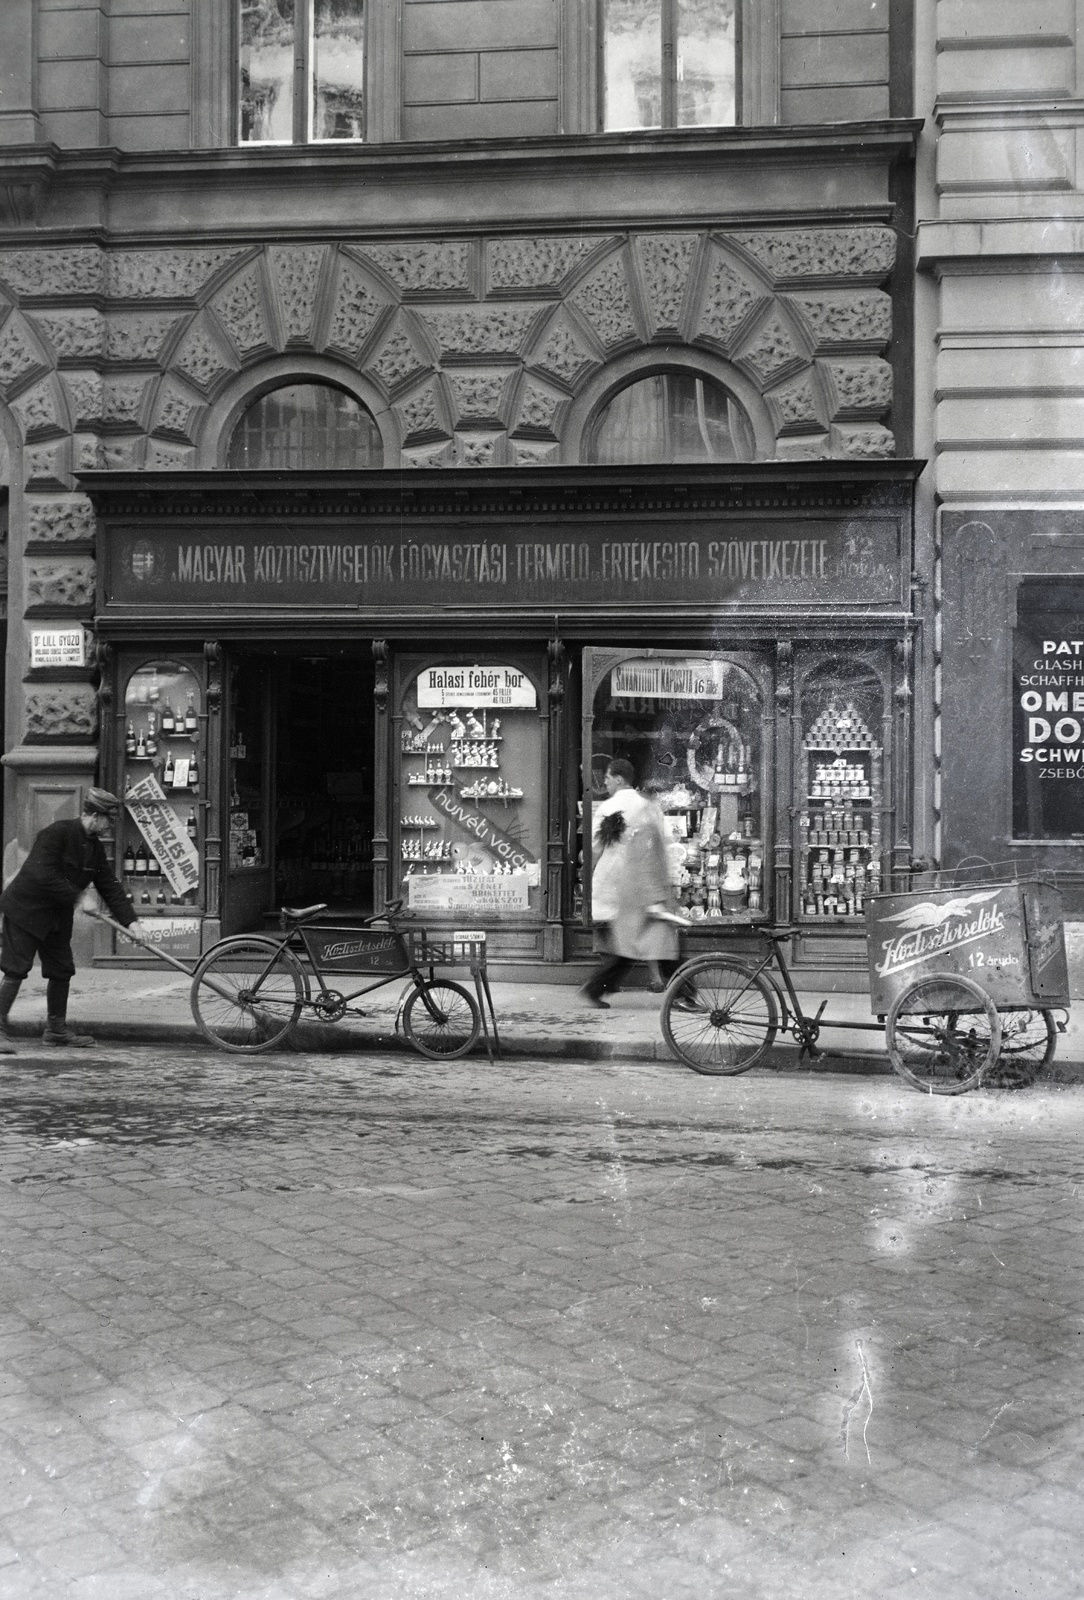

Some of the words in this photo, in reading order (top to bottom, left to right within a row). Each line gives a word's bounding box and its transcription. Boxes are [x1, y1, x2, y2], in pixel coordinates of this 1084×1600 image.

[178, 545, 246, 583] MAGYAR
[429, 671, 464, 688] Halasi
[469, 670, 500, 688] fehér
[504, 670, 524, 688] bor
[1029, 717, 1084, 744] DO
[1020, 748, 1084, 763] SCHW
[152, 838, 169, 861] MOST
[168, 841, 186, 860] ÉS
[177, 859, 199, 885] JAM
[370, 956, 380, 965] 12
[968, 951, 985, 967] 12
